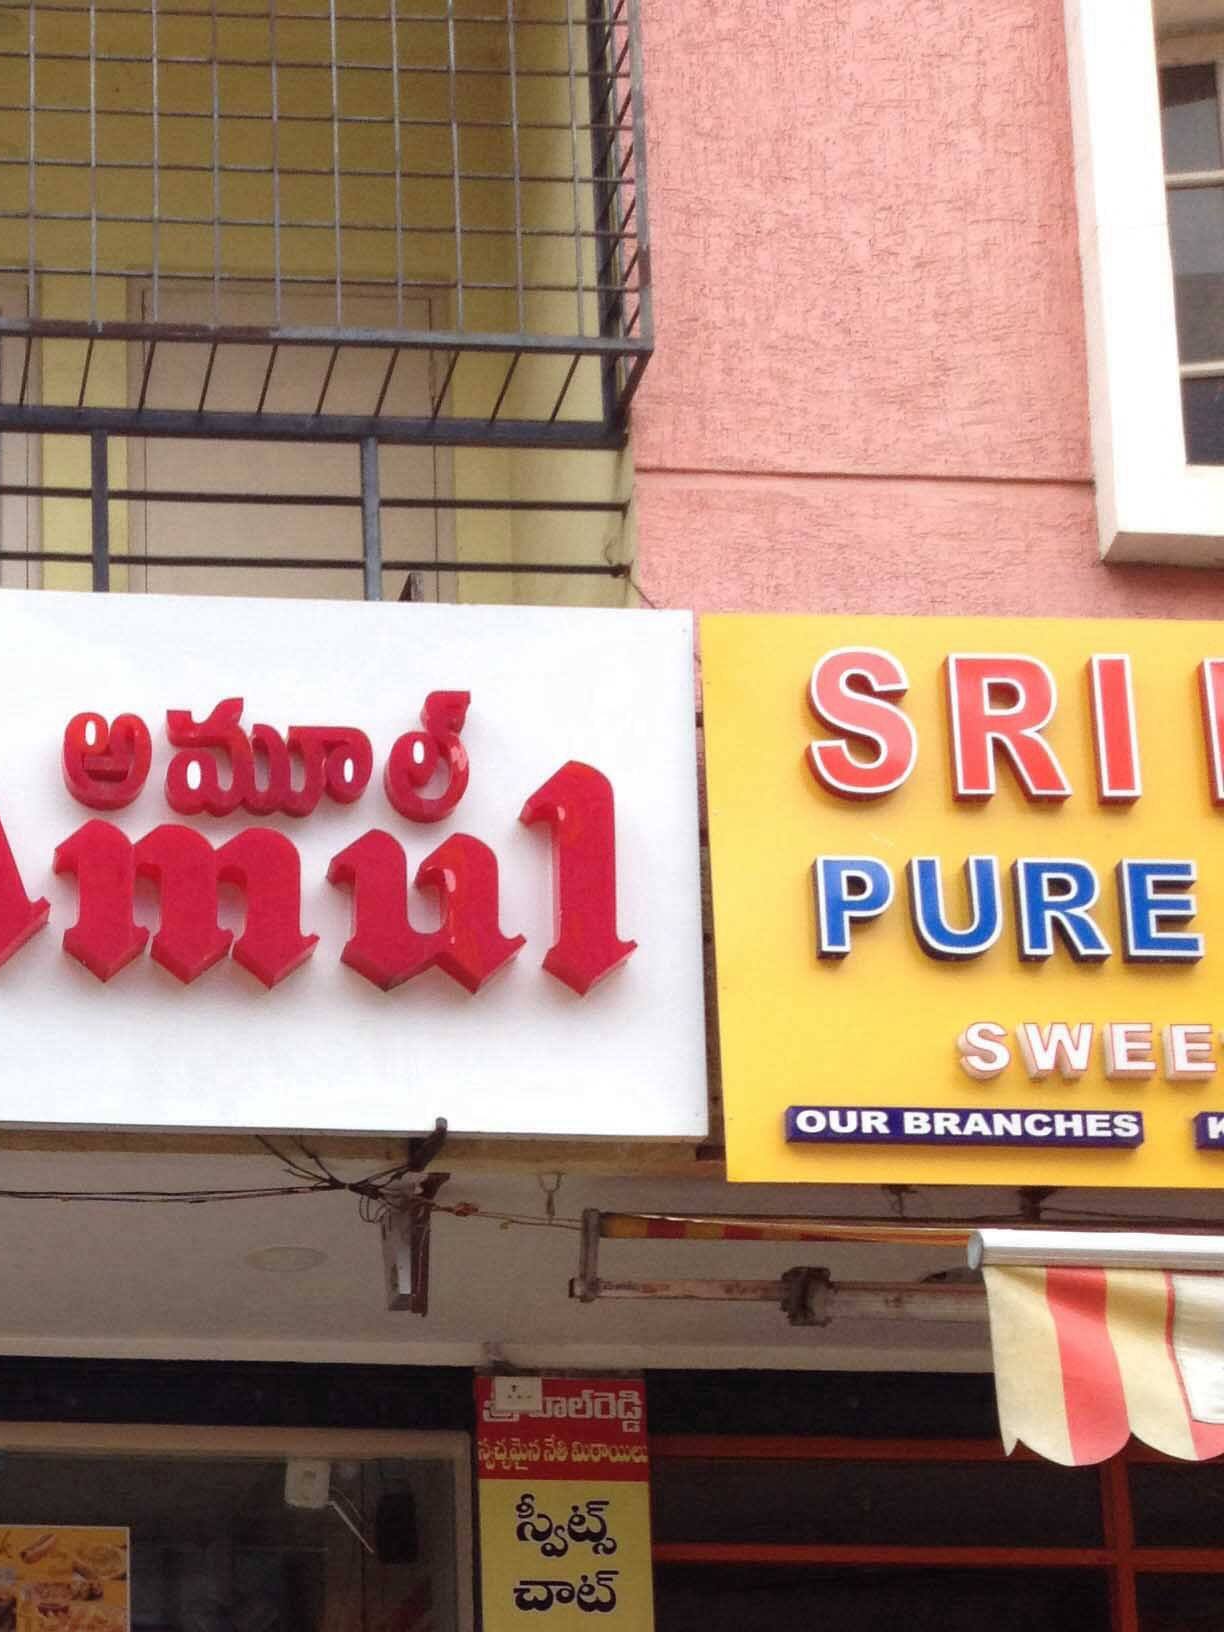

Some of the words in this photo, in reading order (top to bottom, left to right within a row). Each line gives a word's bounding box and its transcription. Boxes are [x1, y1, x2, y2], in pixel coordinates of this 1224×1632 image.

[63, 690, 472, 823] అమూల్
[806, 646, 1143, 804] SRI
[813, 855, 1205, 965] PURE
[958, 1021, 1224, 1082] SWEE
[795, 1108, 892, 1135] OUR
[903, 1110, 1141, 1138] BRANCHES
[516, 1493, 617, 1557] స్వీట్స్
[513, 1570, 619, 1612] చాట్
